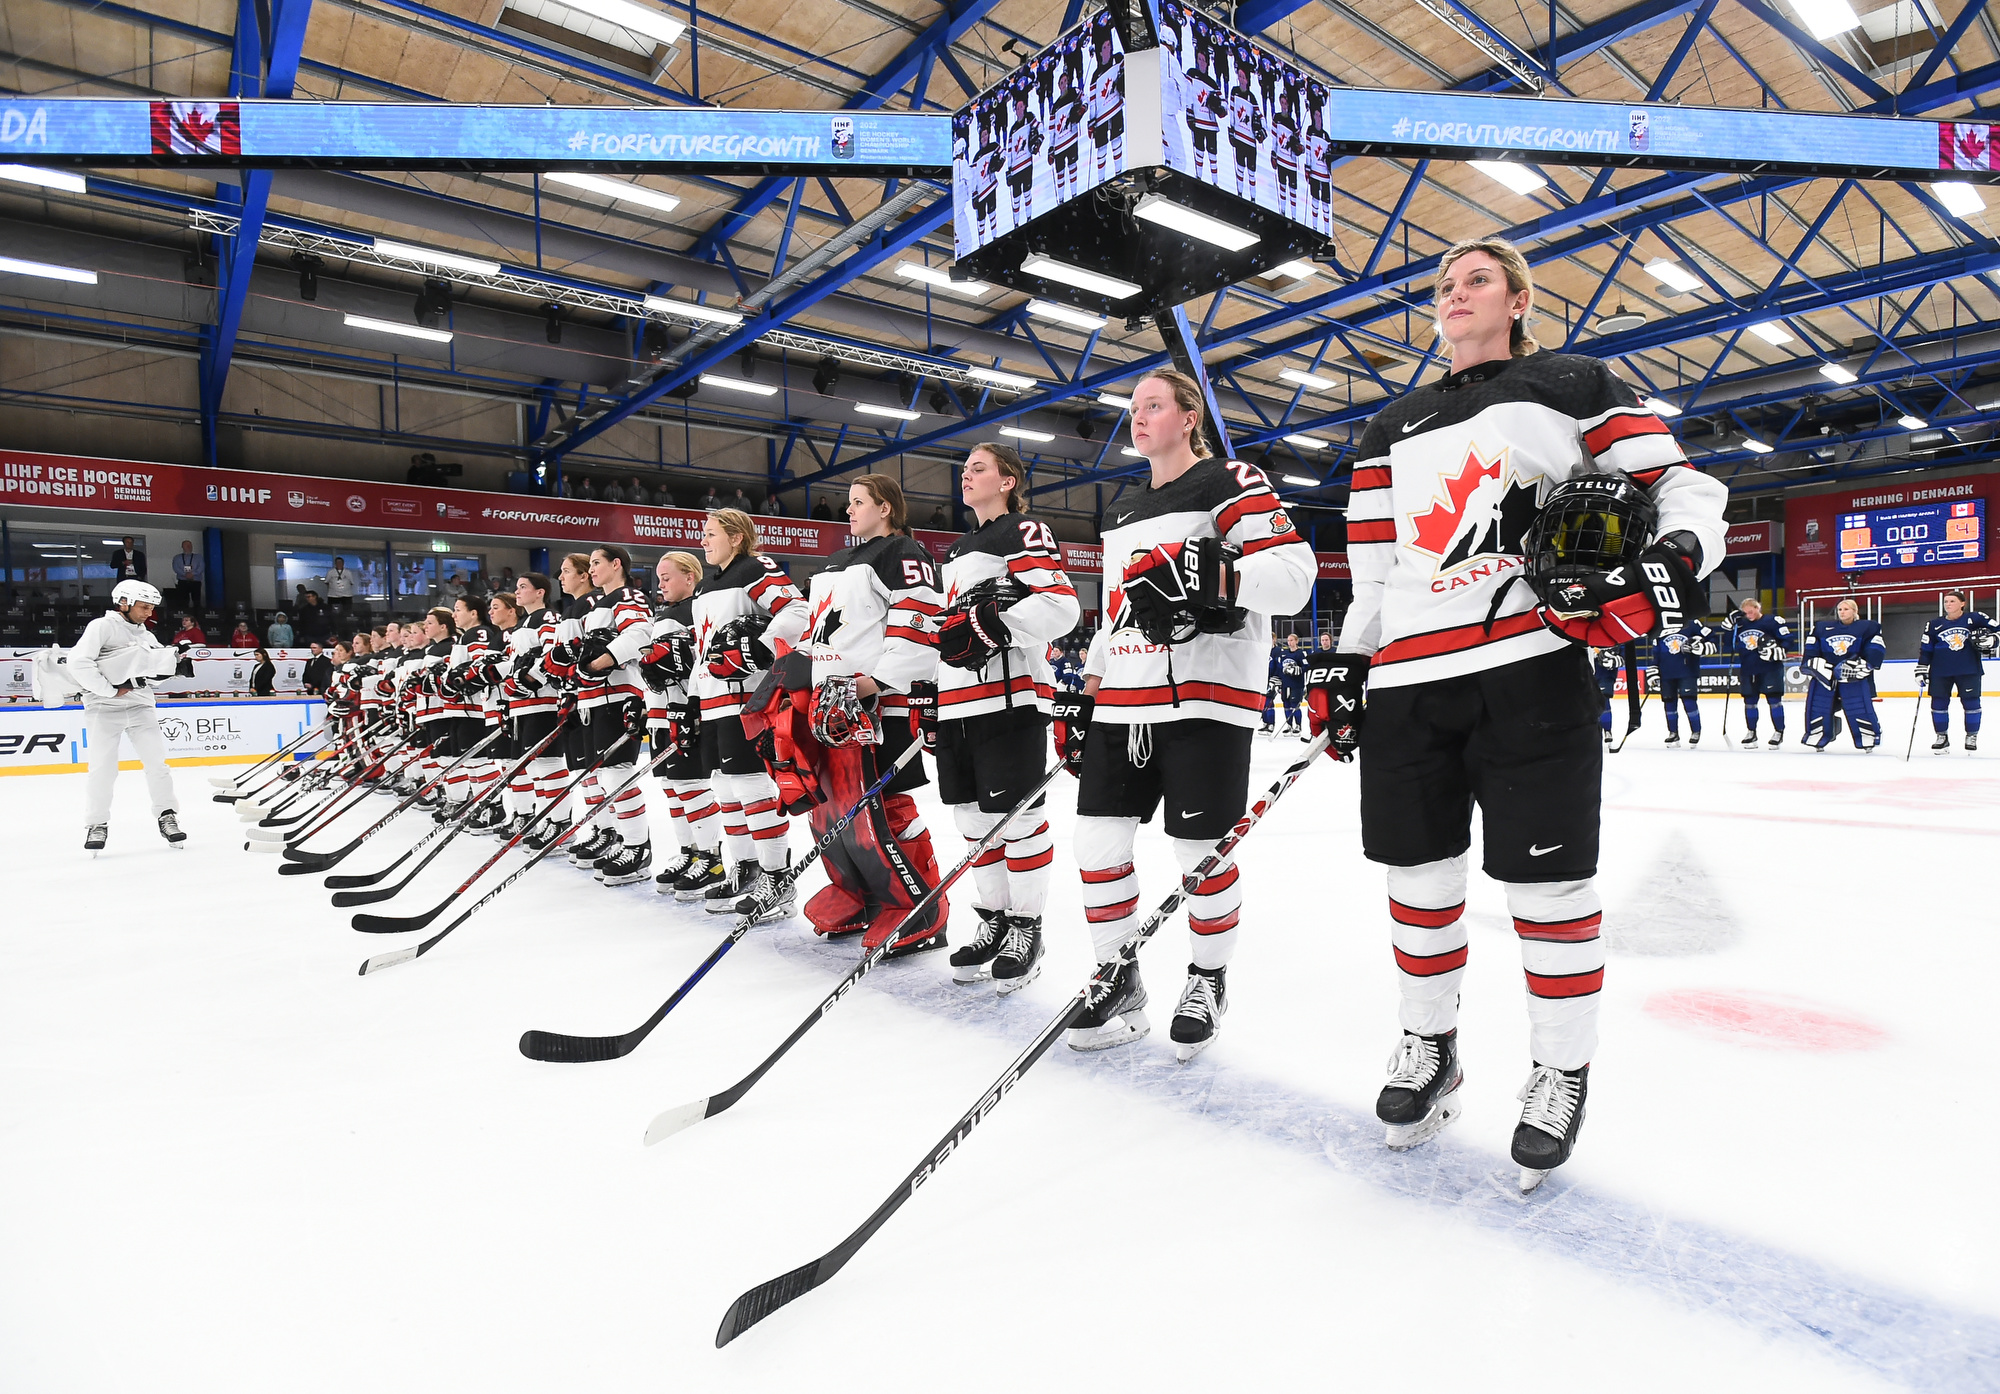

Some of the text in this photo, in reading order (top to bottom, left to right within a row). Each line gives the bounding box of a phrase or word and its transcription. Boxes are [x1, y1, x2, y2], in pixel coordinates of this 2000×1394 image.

[0, 107, 47, 146] DA
[1392, 117, 1620, 150] #FORFUTUREGROWTH
[567, 129, 821, 160] #FORFUTUREGROWTH
[4, 463, 153, 488] IIHF ICE HOCKEY
[114, 486, 151, 496] HERNING
[221, 486, 272, 504] IIHF
[1575, 481, 1628, 496] TELUS
[1852, 484, 1974, 508] HERNING DENMARK
[114, 493, 151, 502] DENMARK
[481, 507, 600, 527] #FORFUTUREGROWTH
[633, 514, 684, 529] WELCOME
[685, 519, 699, 529] TO
[633, 525, 682, 539] WOMEN'S
[768, 525, 783, 536] ICE
[785, 526, 819, 538] HOCKEY
[1018, 520, 1057, 550] 26
[1955, 522, 1969, 536] 4
[1066, 549, 1096, 559] WELCOME
[1067, 558, 1095, 568] WOMEN'S
[901, 559, 935, 587] 50
[621, 587, 646, 604] 12
[1967, 617, 1973, 625] A
[476, 629, 488, 642] 3
[196, 718, 241, 734] BFL
[196, 734, 242, 742] CANADA
[885, 843, 921, 896] BAUER
[470, 866, 527, 916] BAUER
[821, 932, 900, 1017] BAUER
[910, 1070, 1020, 1195] BAUER
